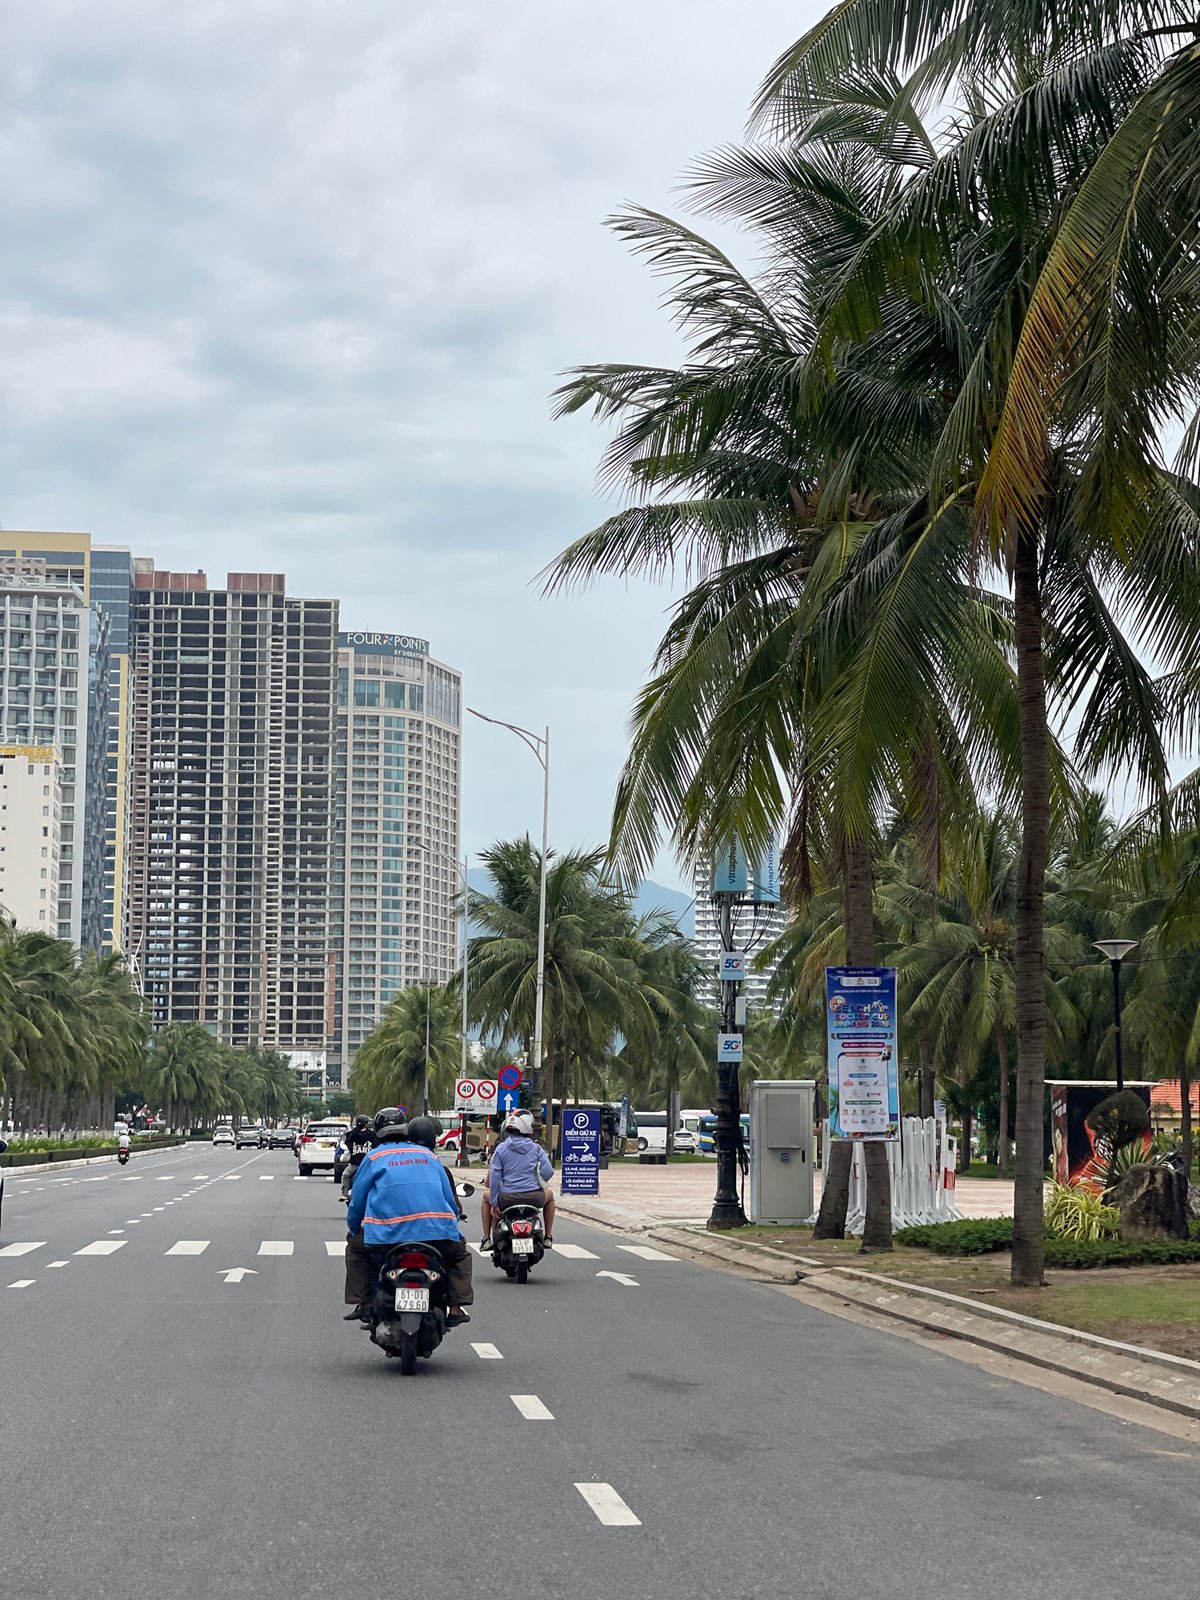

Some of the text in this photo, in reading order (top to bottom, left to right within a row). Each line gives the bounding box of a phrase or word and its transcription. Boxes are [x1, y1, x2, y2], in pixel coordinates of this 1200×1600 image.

[347, 633, 426, 652] FOUR POINTS
[724, 958, 741, 969] 5G
[723, 1040, 740, 1051] 5G
[461, 1084, 472, 1094] 40
